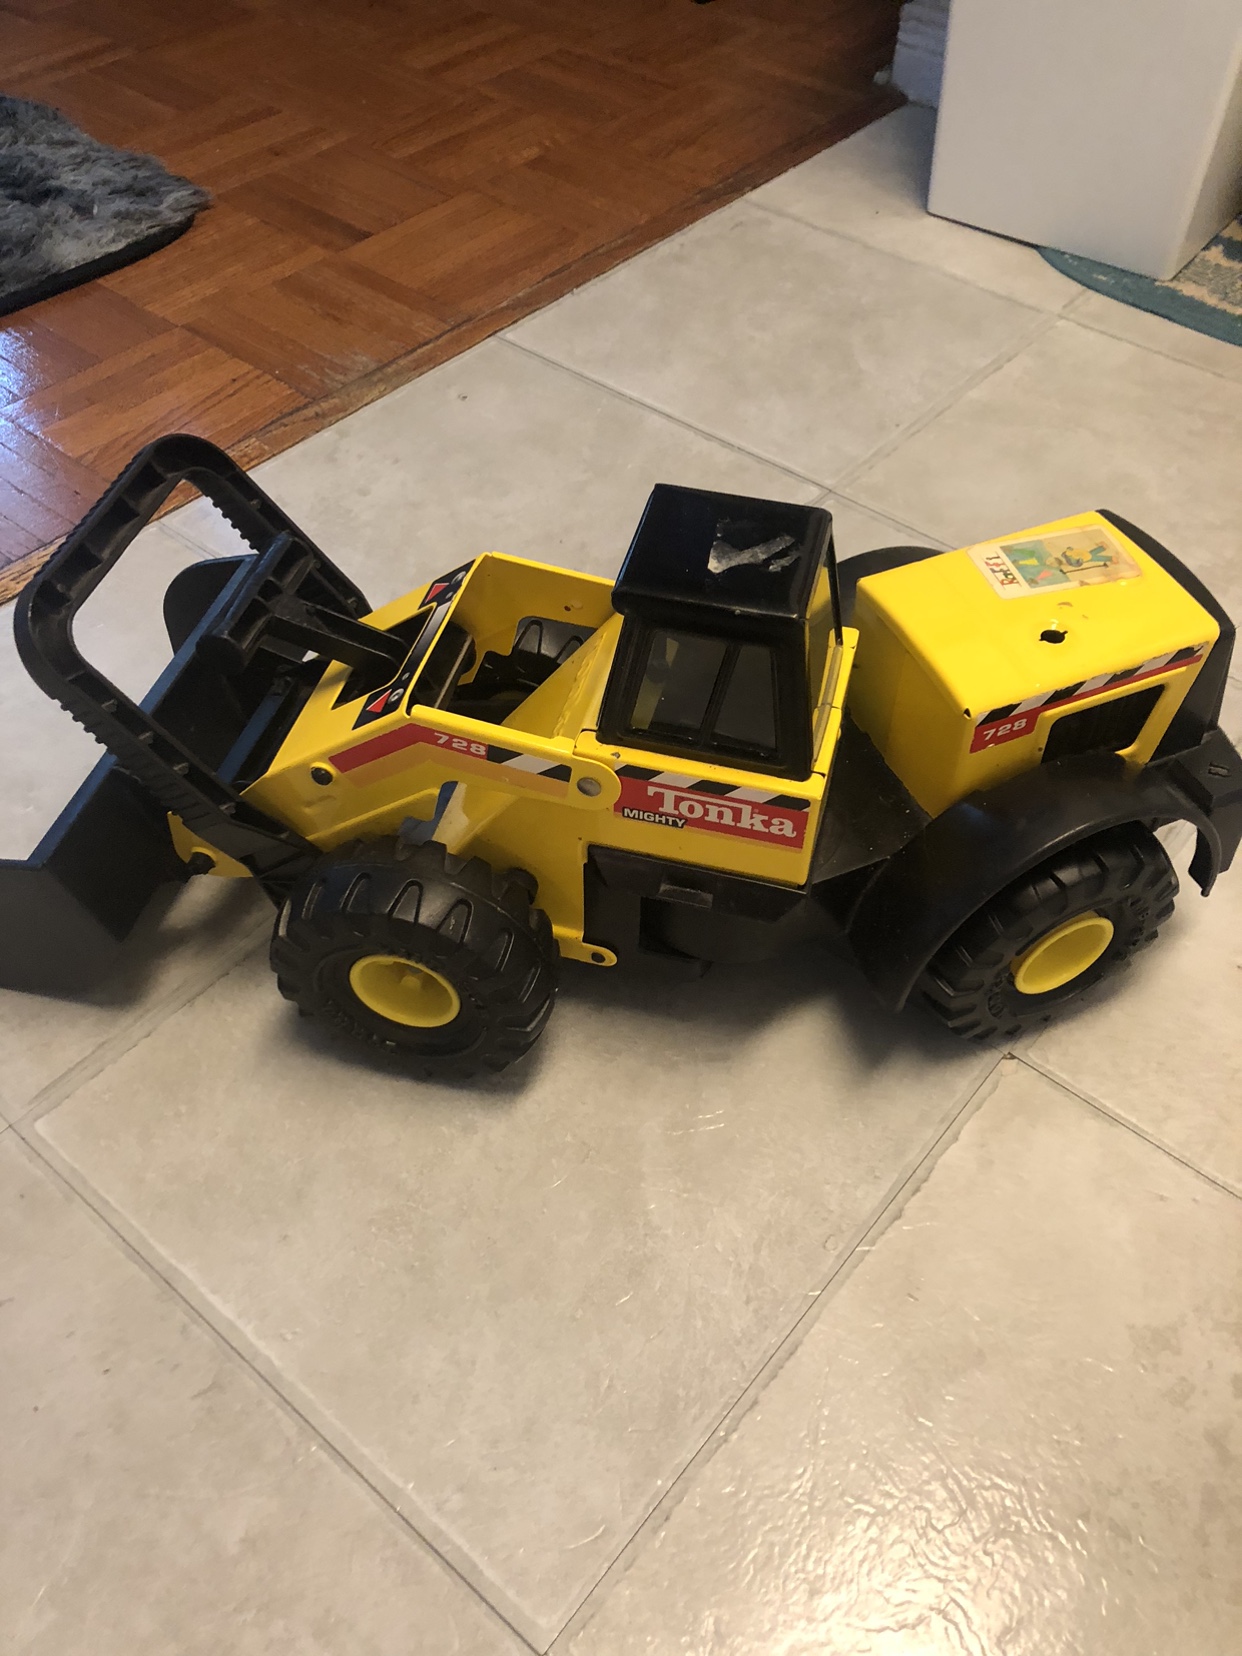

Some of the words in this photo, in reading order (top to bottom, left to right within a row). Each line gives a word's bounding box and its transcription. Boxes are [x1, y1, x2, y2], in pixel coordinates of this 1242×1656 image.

[983, 718, 1028, 741] 728
[434, 732, 487, 756] 728
[623, 808, 686, 828] MIGHTY
[647, 785, 797, 838] Tonka
